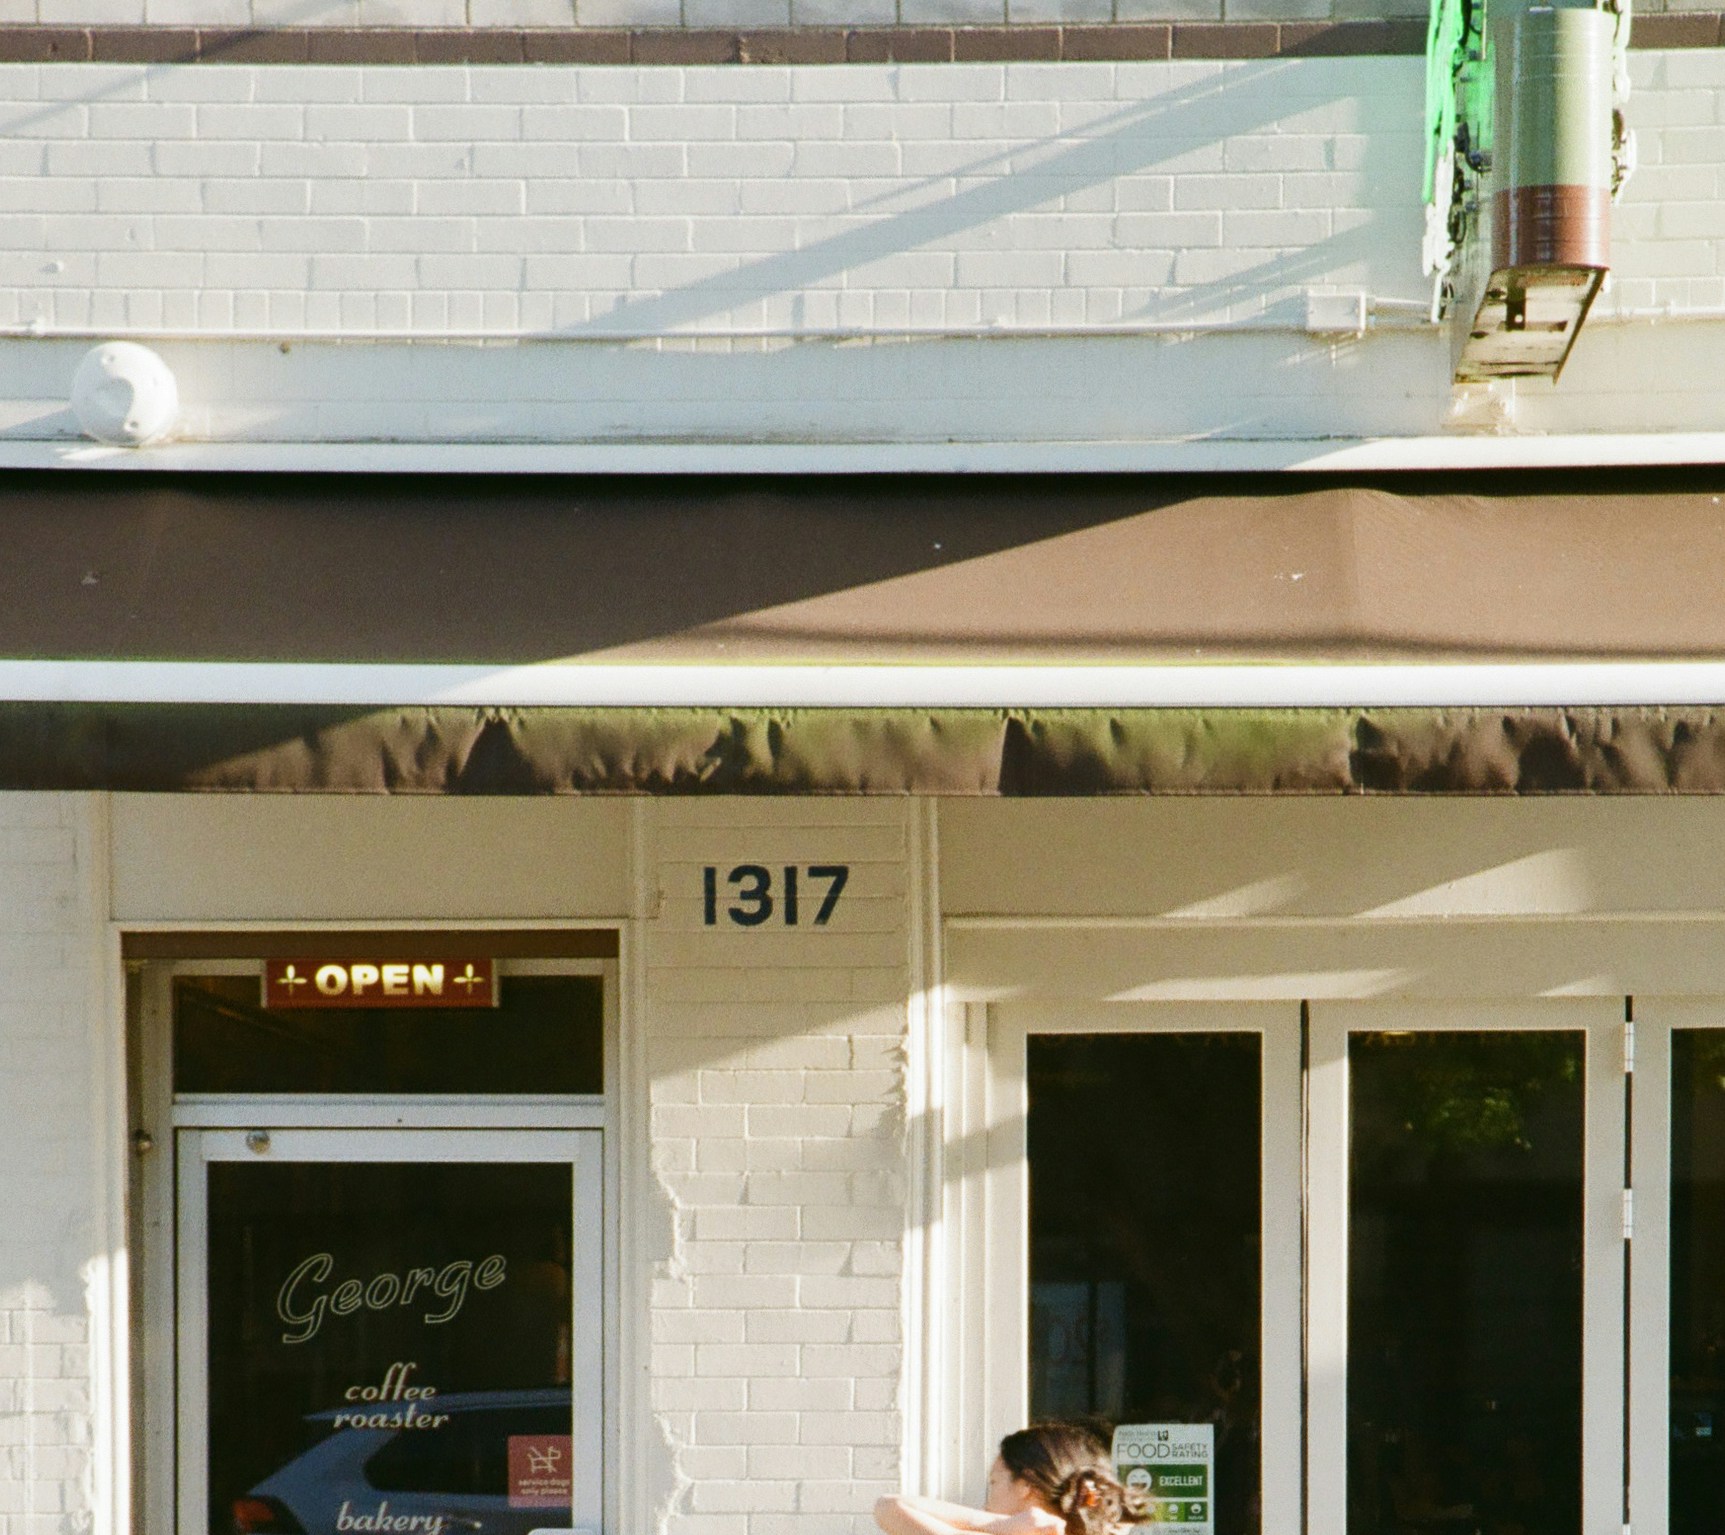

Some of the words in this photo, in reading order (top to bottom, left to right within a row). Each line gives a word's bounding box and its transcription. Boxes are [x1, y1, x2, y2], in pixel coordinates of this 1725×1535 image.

[704, 864, 849, 927] 1317
[314, 963, 445, 997] OPEN
[276, 1252, 507, 1344] George
[345, 1362, 437, 1402] coffee
[333, 1404, 450, 1430] roaster
[1117, 1443, 1170, 1459] FOOD
[1171, 1443, 1208, 1451] SAFETY
[1171, 1451, 1208, 1459] RATING
[1159, 1475, 1203, 1487] EXCELLENT
